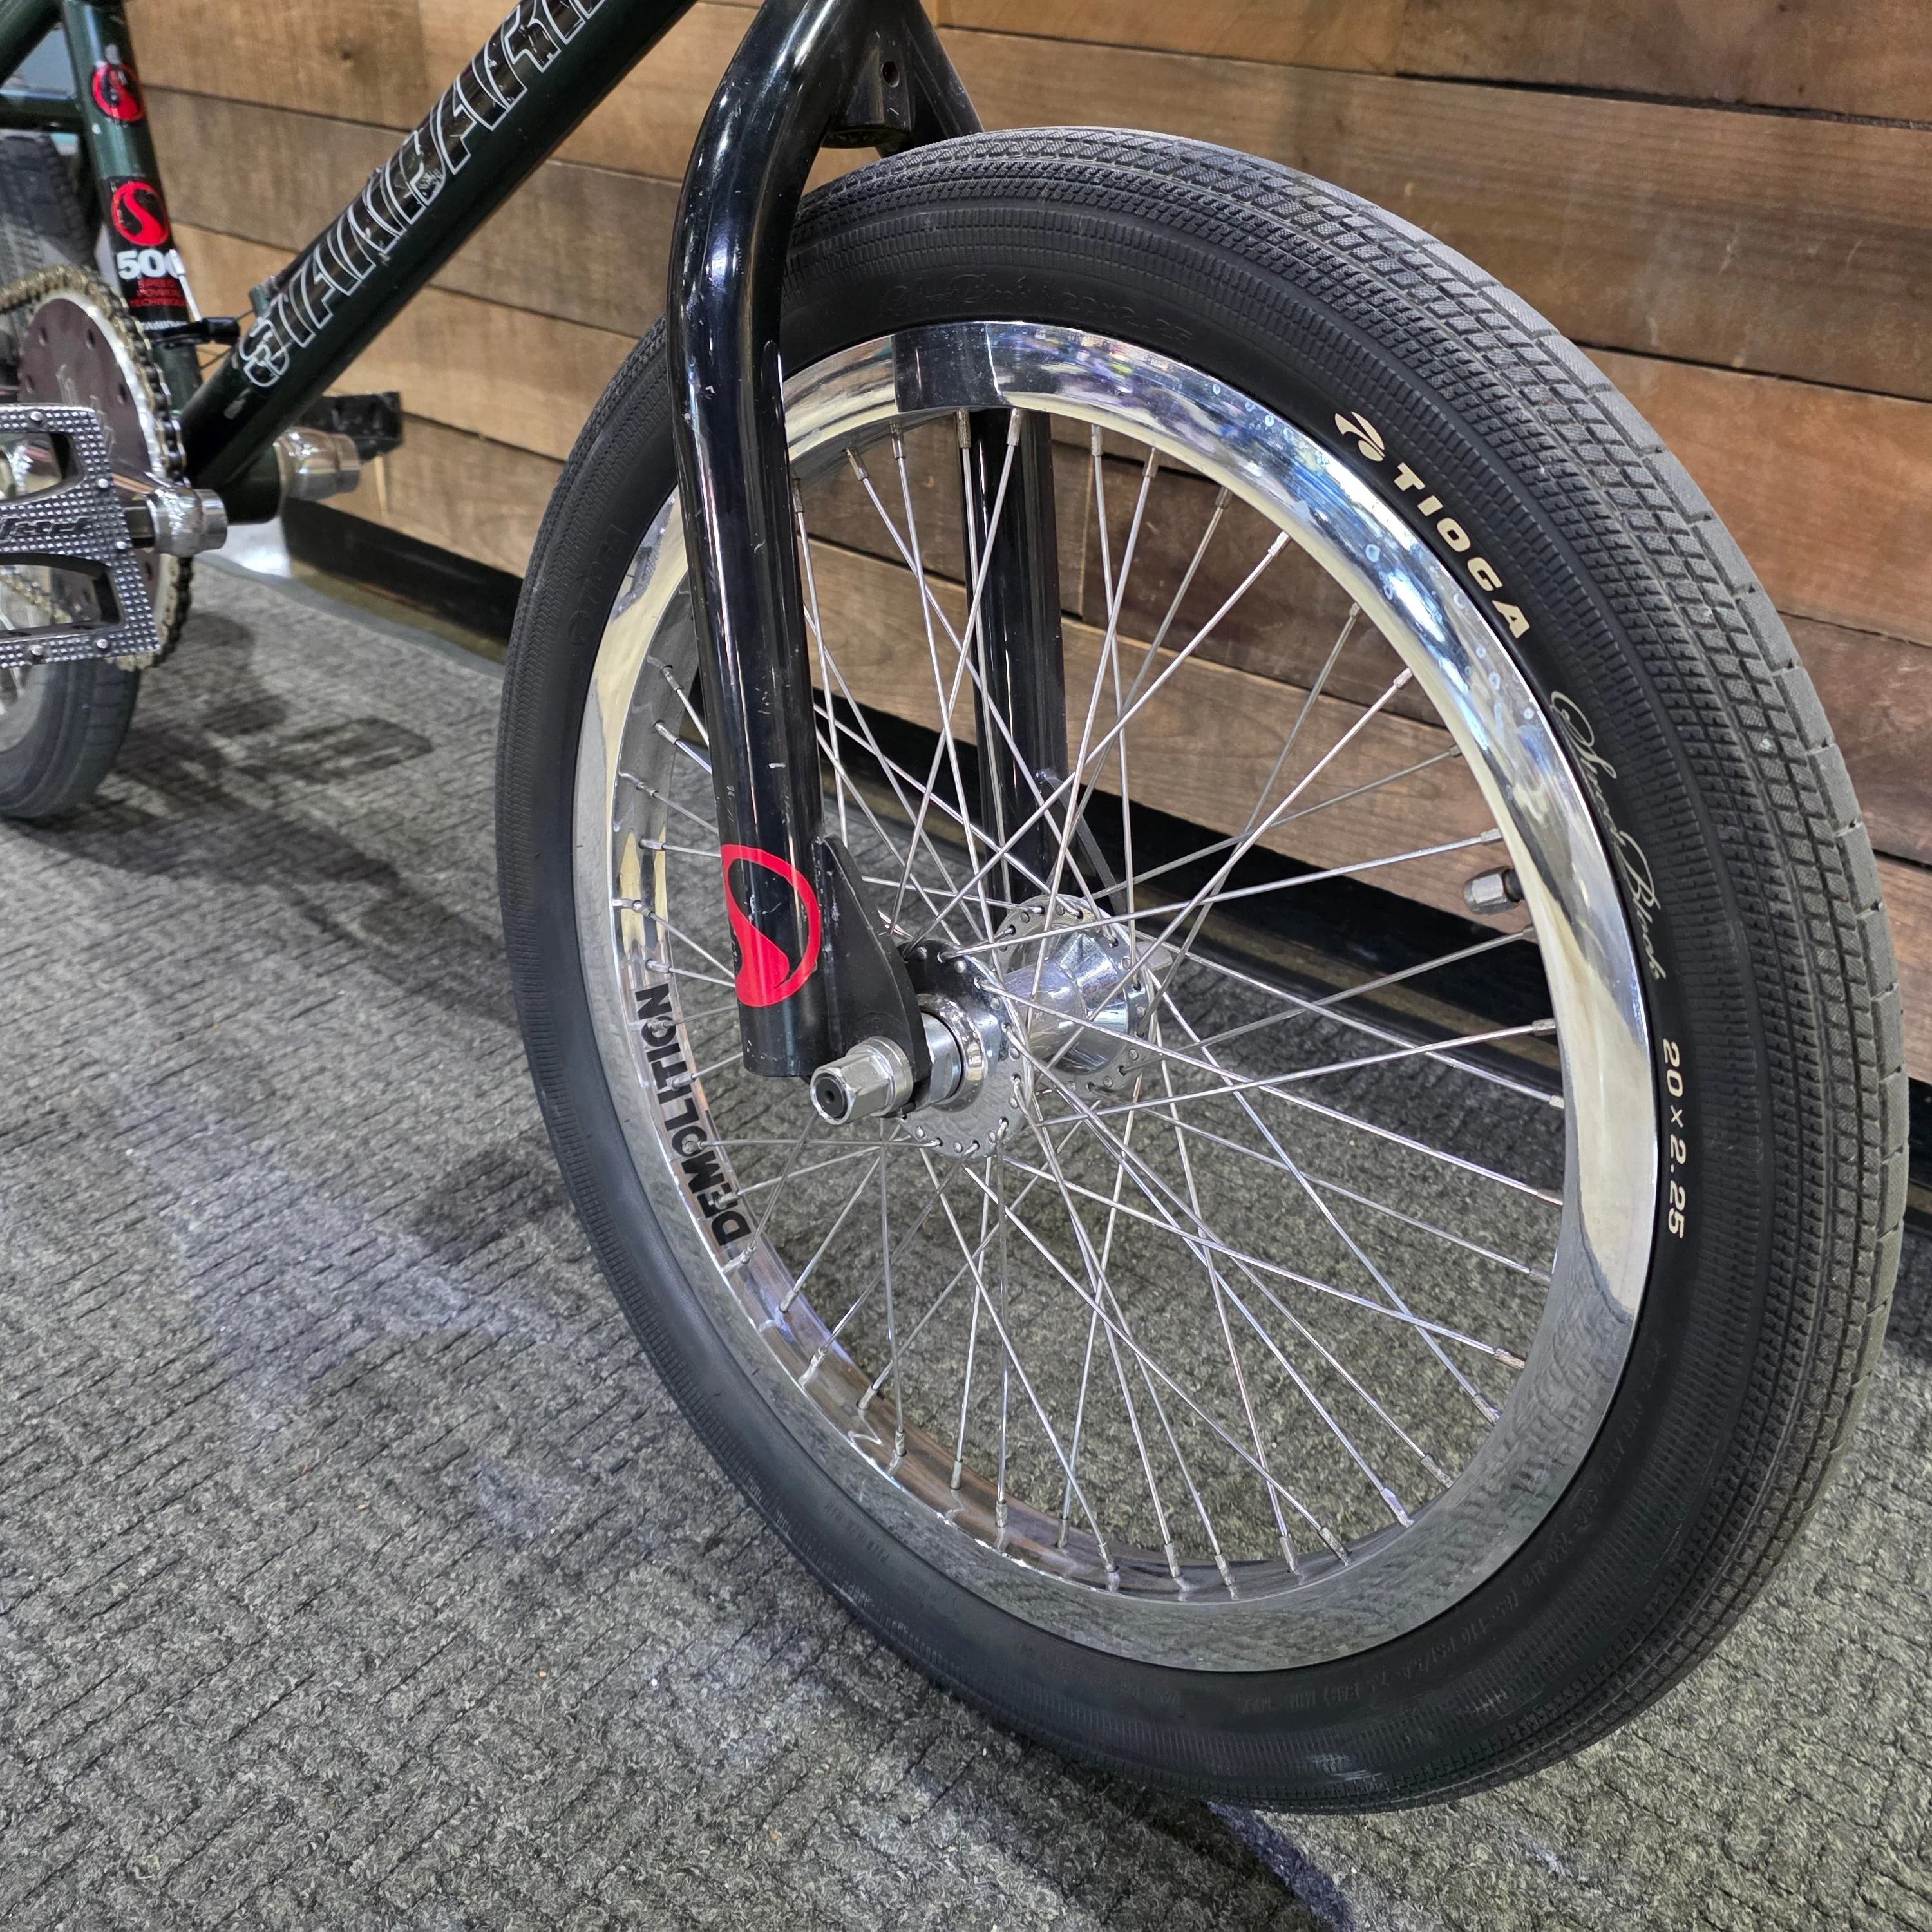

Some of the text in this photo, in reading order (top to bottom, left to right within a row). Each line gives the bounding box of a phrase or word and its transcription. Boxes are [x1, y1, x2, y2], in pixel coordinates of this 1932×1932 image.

[1393, 462, 1531, 639] TIOGA
[1615, 831, 1667, 980] Block
[635, 984, 752, 1246] DEMOLITION
